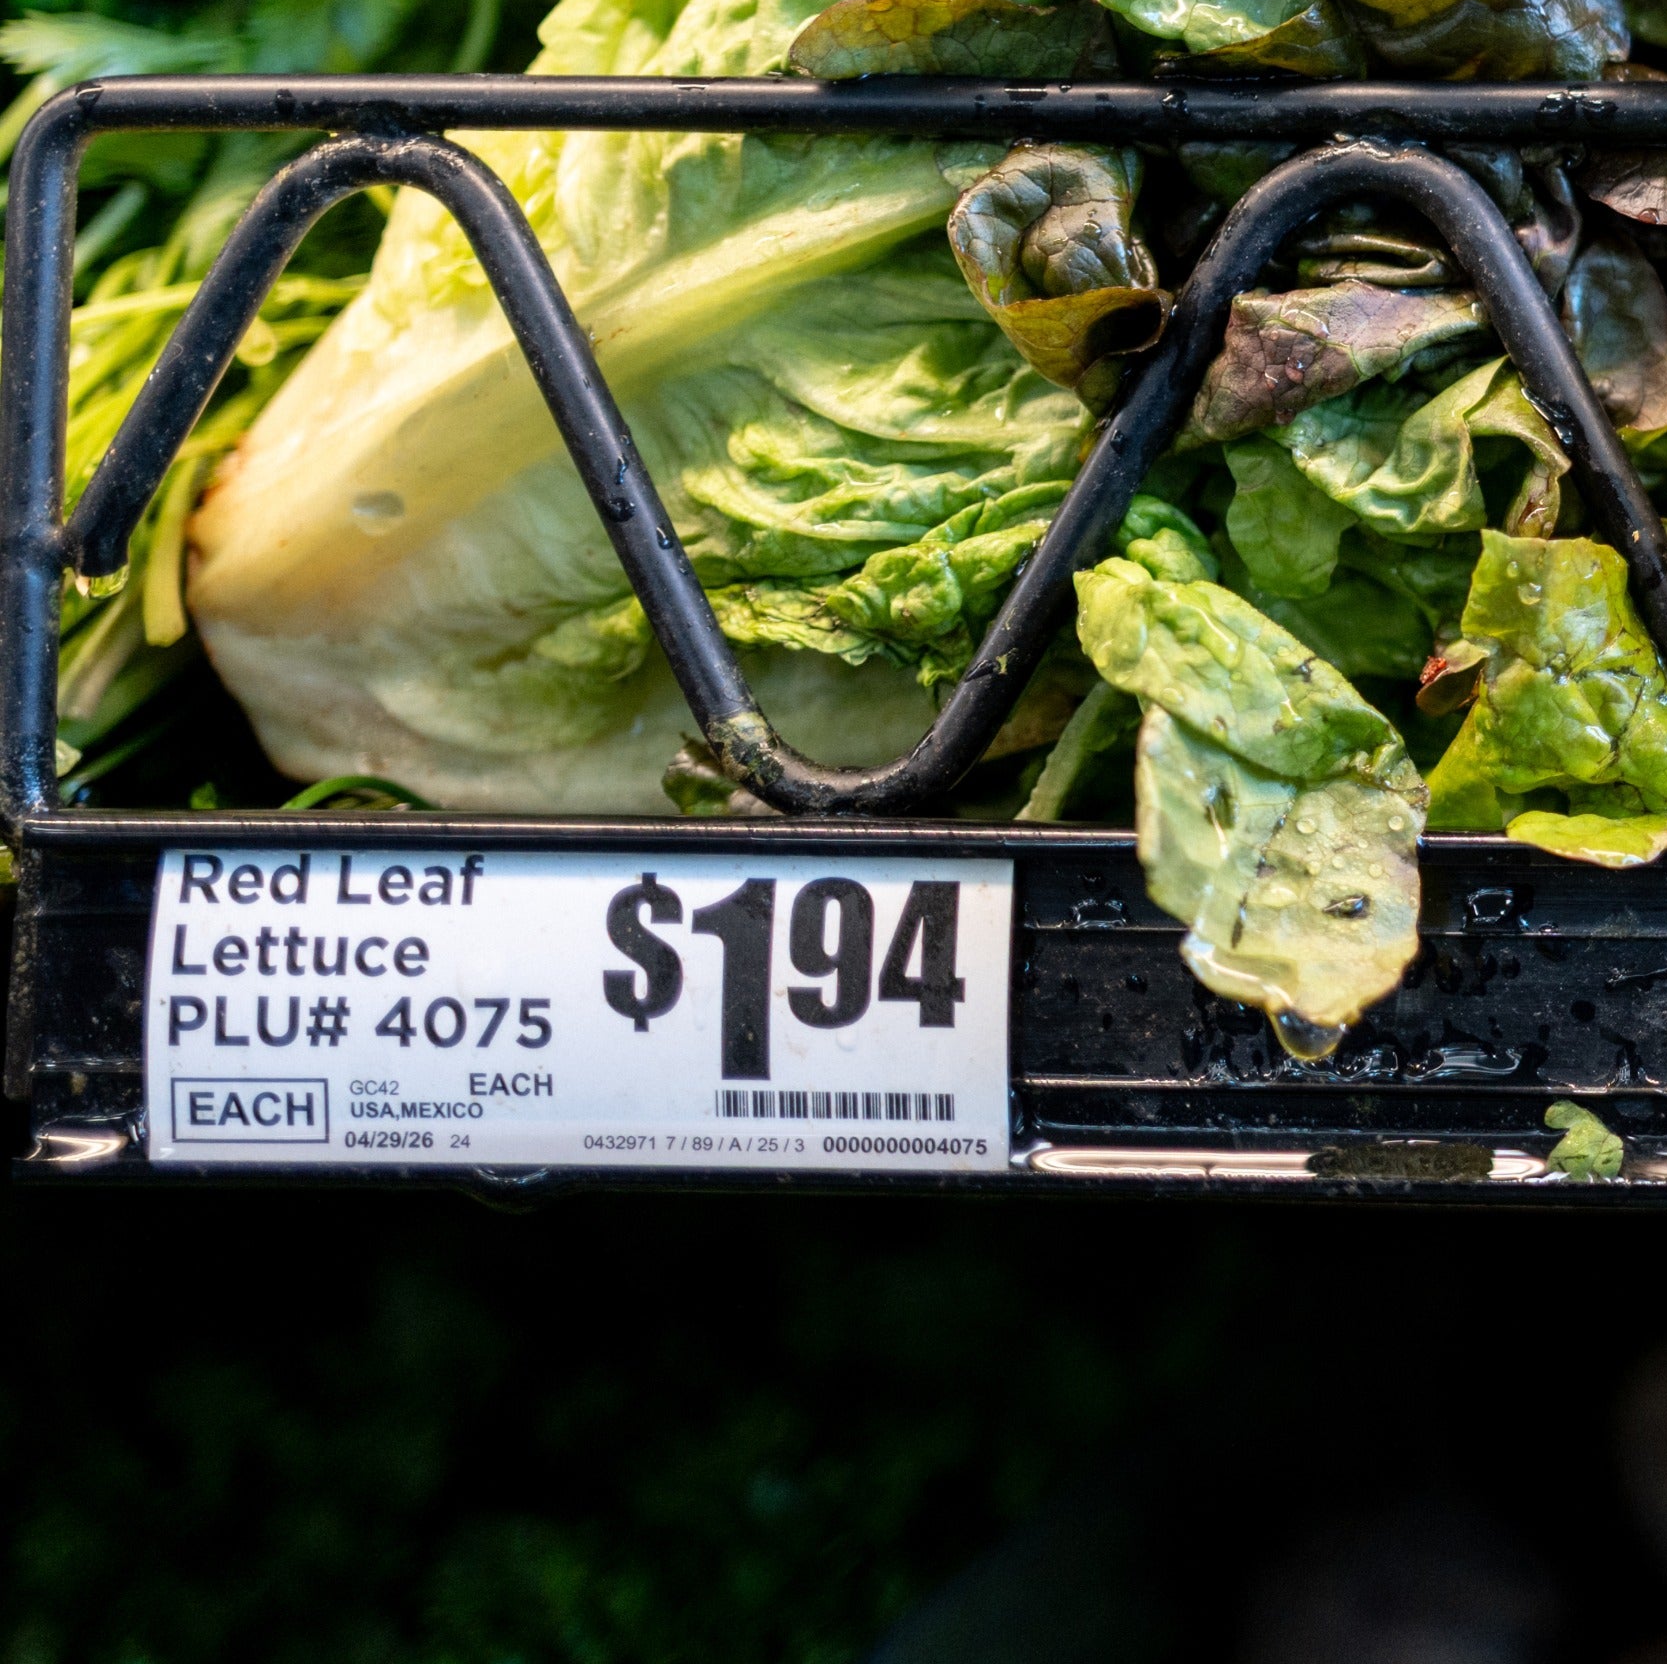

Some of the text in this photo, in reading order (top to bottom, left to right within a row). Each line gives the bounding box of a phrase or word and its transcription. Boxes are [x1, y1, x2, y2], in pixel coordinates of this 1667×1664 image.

[178, 853, 485, 906] Red Leaf
[171, 923, 430, 978] Lettuce
[602, 871, 966, 1081] $194
[168, 994, 553, 1049] PLU# 4075
[349, 1080, 400, 1097] GC42
[469, 1072, 554, 1098] EACH
[188, 1091, 315, 1127] EACH
[350, 1101, 484, 1122] USA,MEXICO
[344, 1131, 471, 1149] 04/29/26 24
[583, 1134, 656, 1151] 0432971
[822, 1136, 988, 1155] 0000000004075
